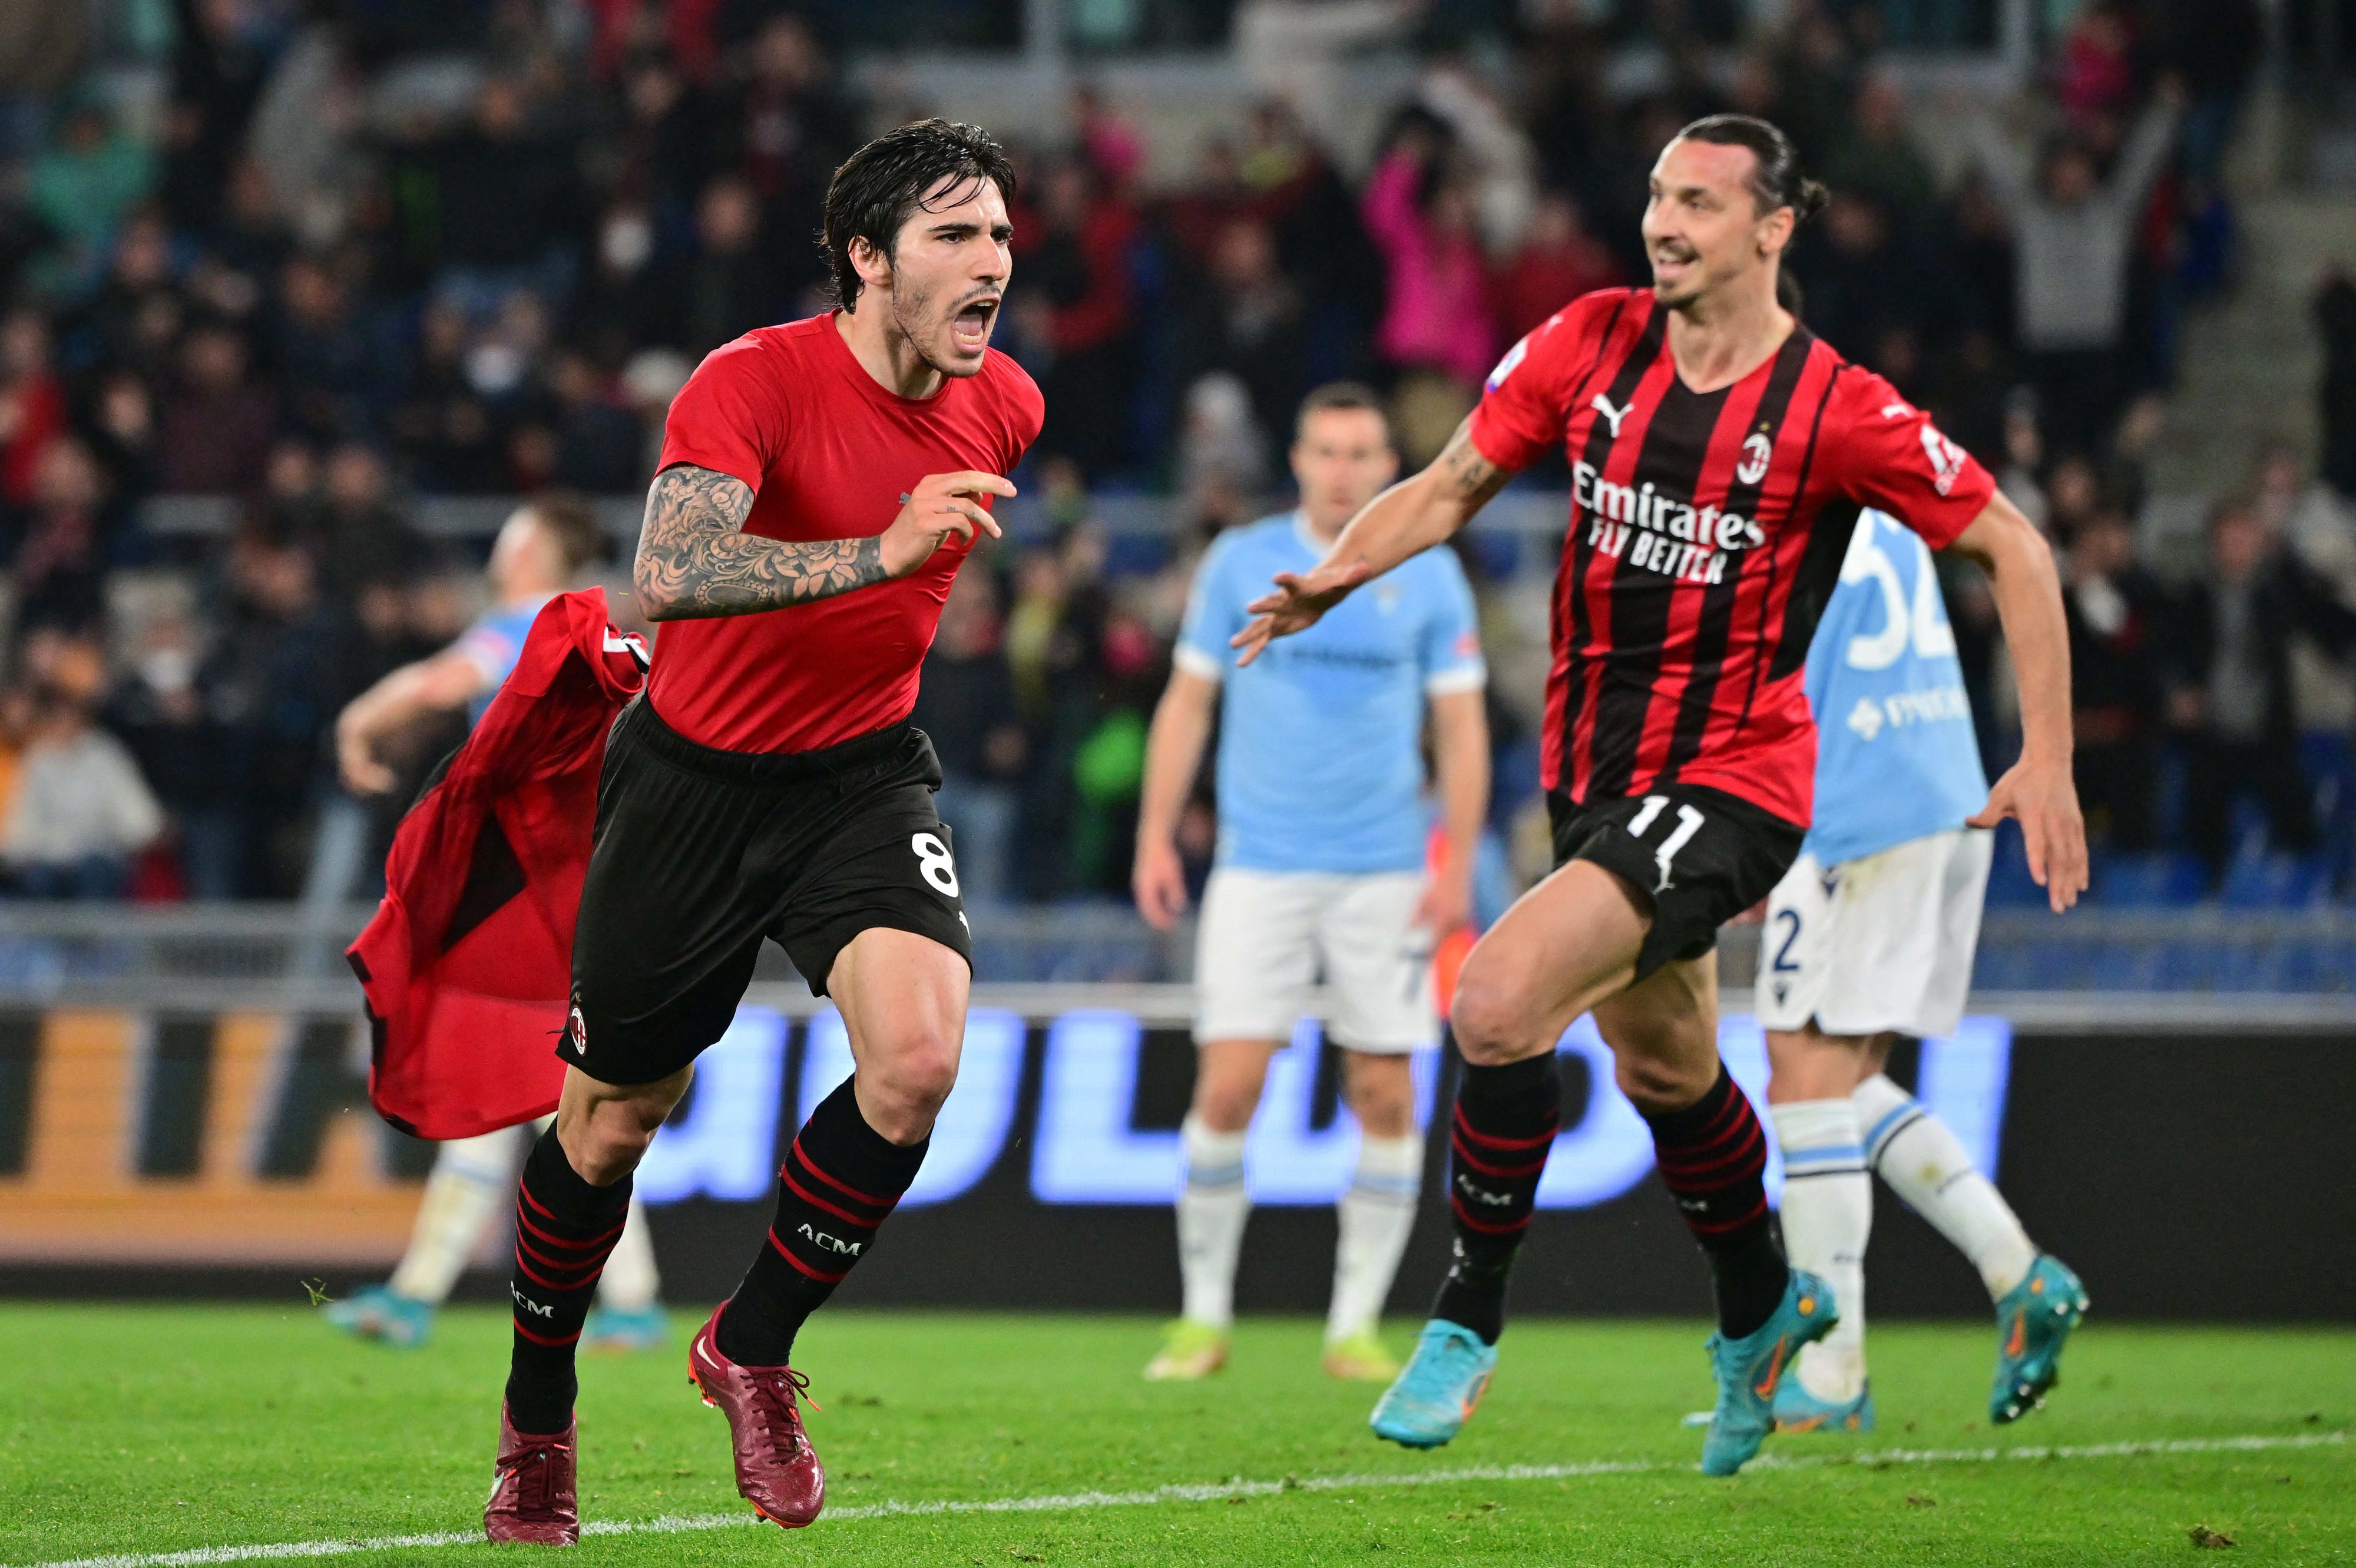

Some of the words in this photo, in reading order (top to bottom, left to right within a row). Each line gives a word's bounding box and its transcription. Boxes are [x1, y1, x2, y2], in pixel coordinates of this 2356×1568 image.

[1572, 459, 1766, 550] Emirates
[1587, 516, 1632, 559] FLY
[1629, 530, 1728, 584] BETTER
[1626, 795, 1705, 859] 11
[911, 832, 959, 898] 8
[797, 1223, 862, 1256] ACM
